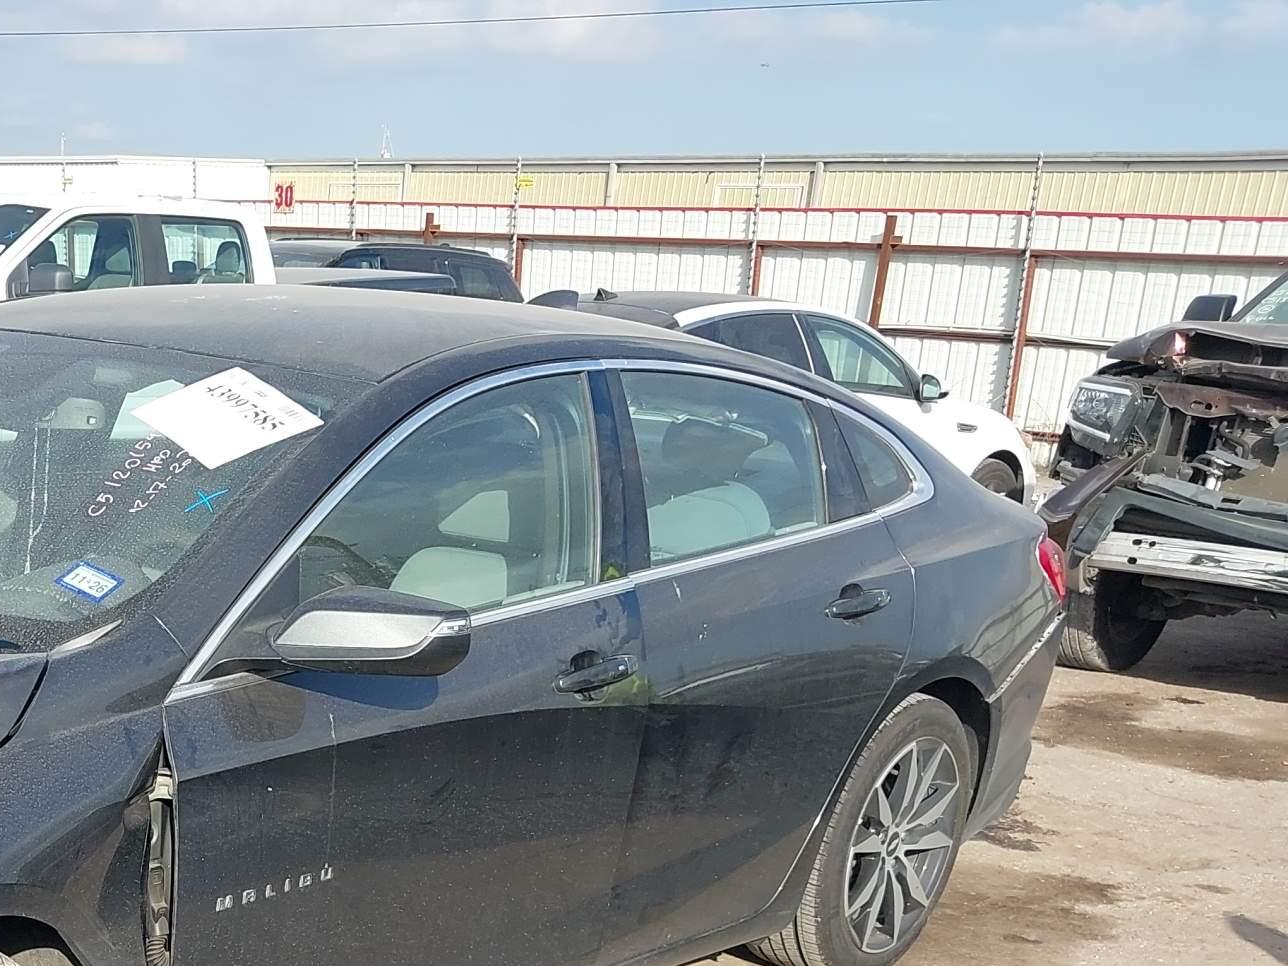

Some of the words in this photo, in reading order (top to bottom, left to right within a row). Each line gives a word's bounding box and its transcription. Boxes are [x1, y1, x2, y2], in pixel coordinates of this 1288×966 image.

[274, 184, 294, 209] 30
[206, 385, 286, 431] 43997585
[214, 862, 334, 912] MALIBU
